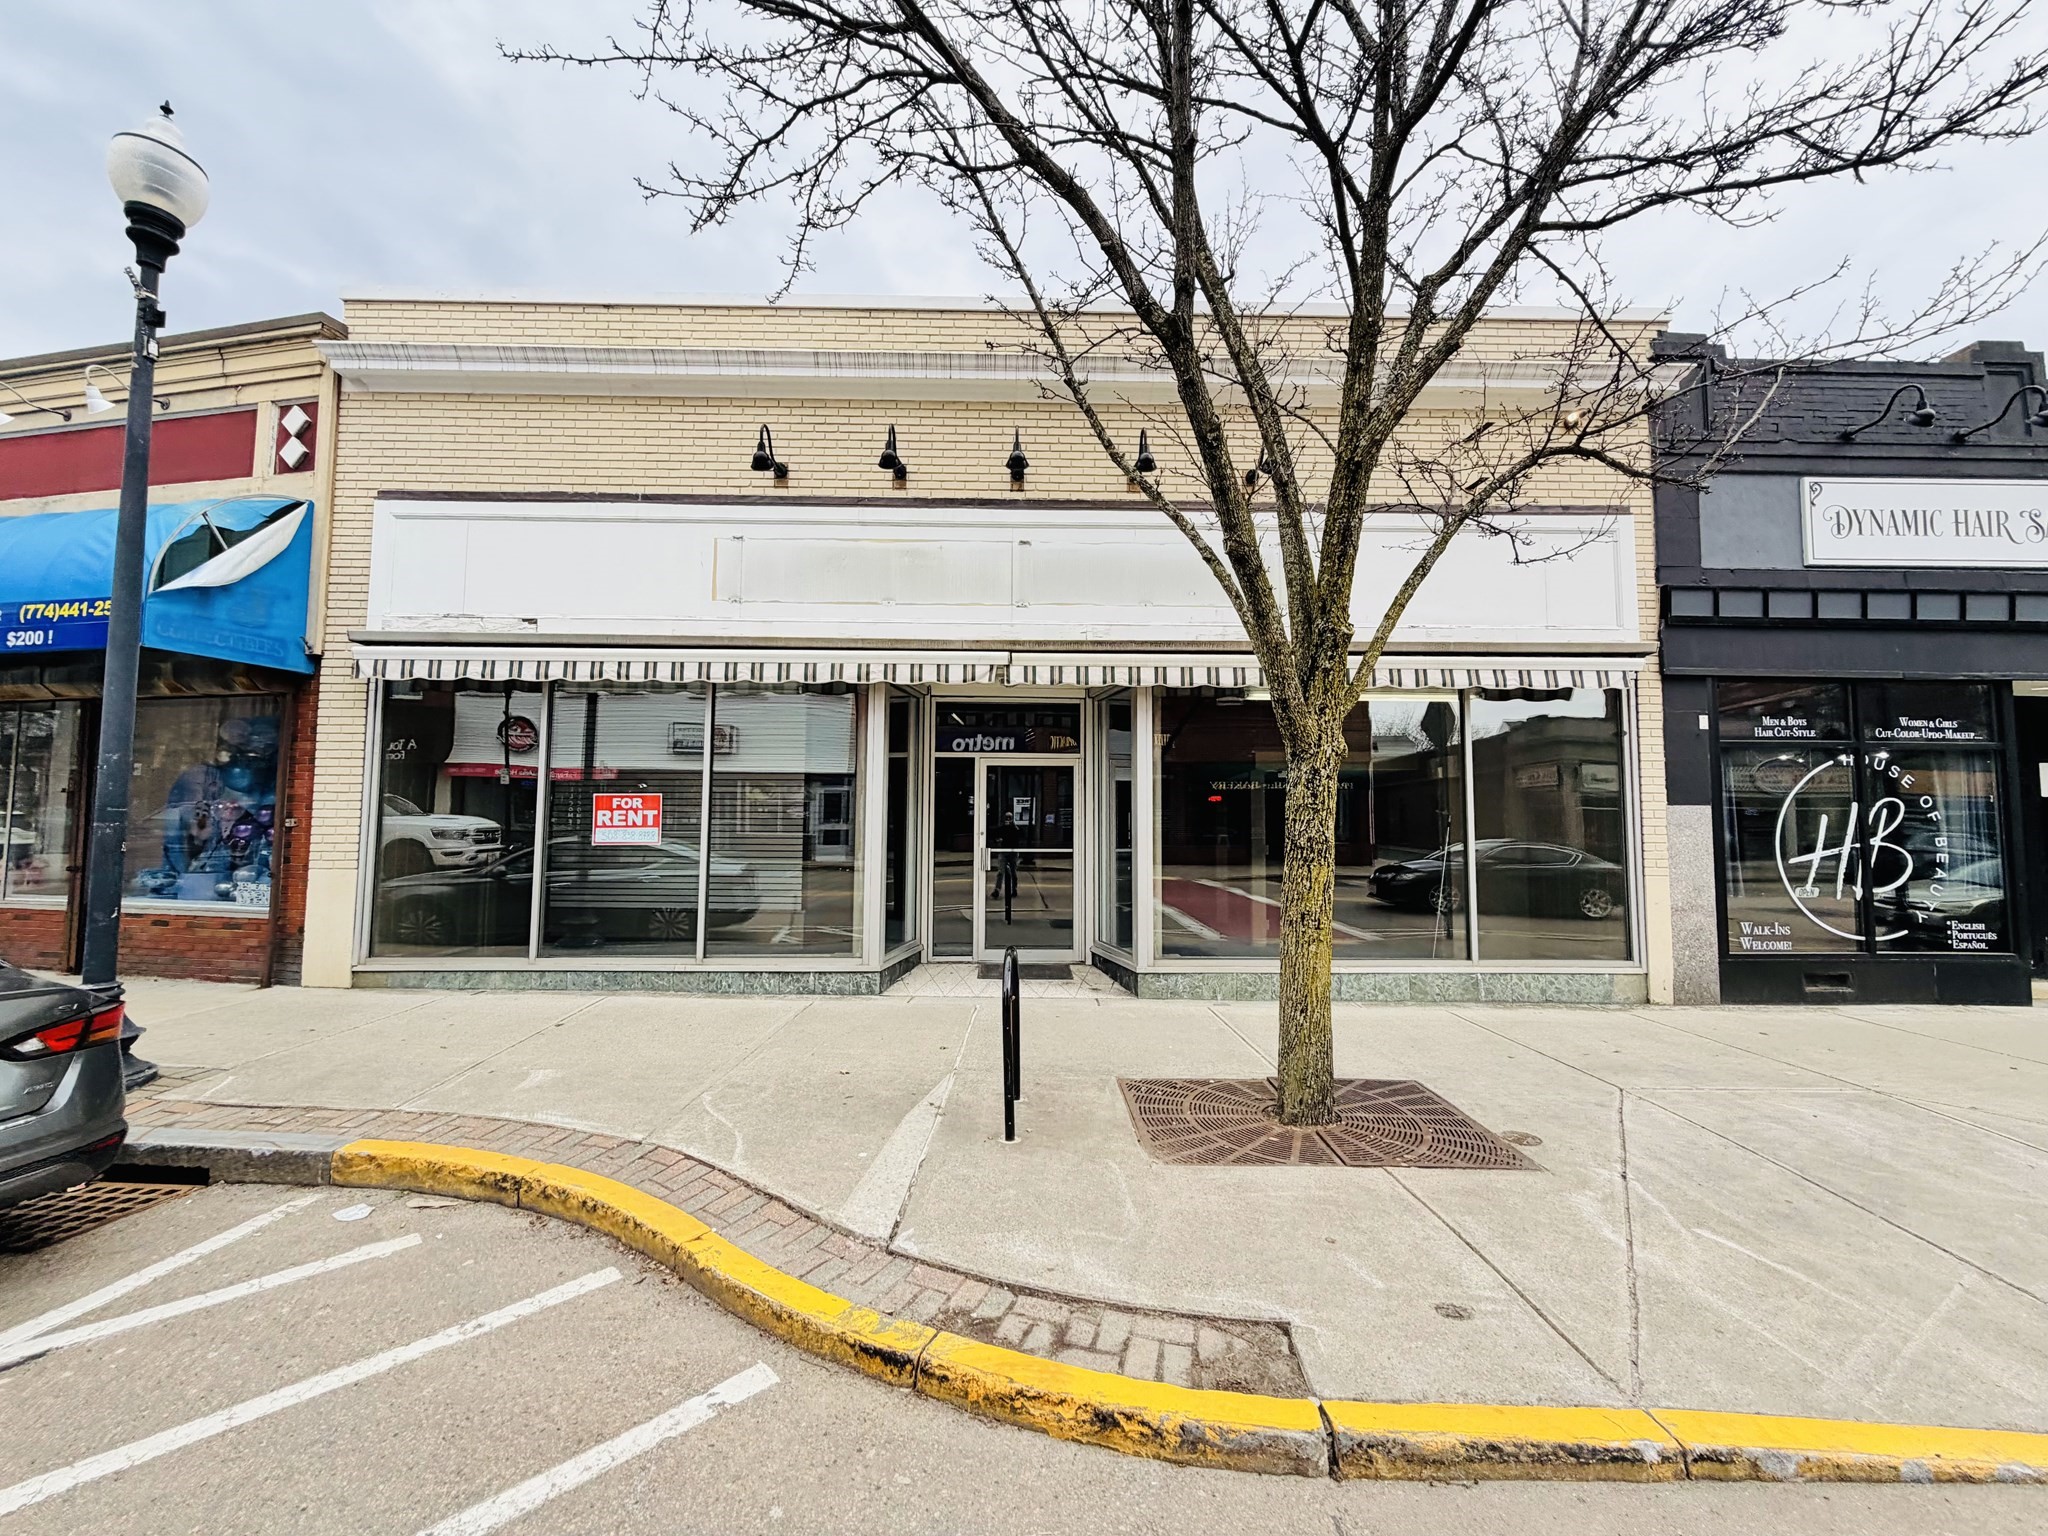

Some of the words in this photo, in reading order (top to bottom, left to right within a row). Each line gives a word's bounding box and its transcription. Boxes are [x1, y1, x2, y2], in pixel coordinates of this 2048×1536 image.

[1952, 509, 2026, 545] HAIR
[2019, 508, 2048, 544] S
[19, 600, 112, 623] (774)441-25
[6, 630, 45, 648] $200
[1780, 718, 1787, 726] &
[1928, 720, 1935, 728] &
[612, 797, 643, 809] FOR
[1919, 795, 1942, 822] OF
[597, 809, 659, 827] RENT
